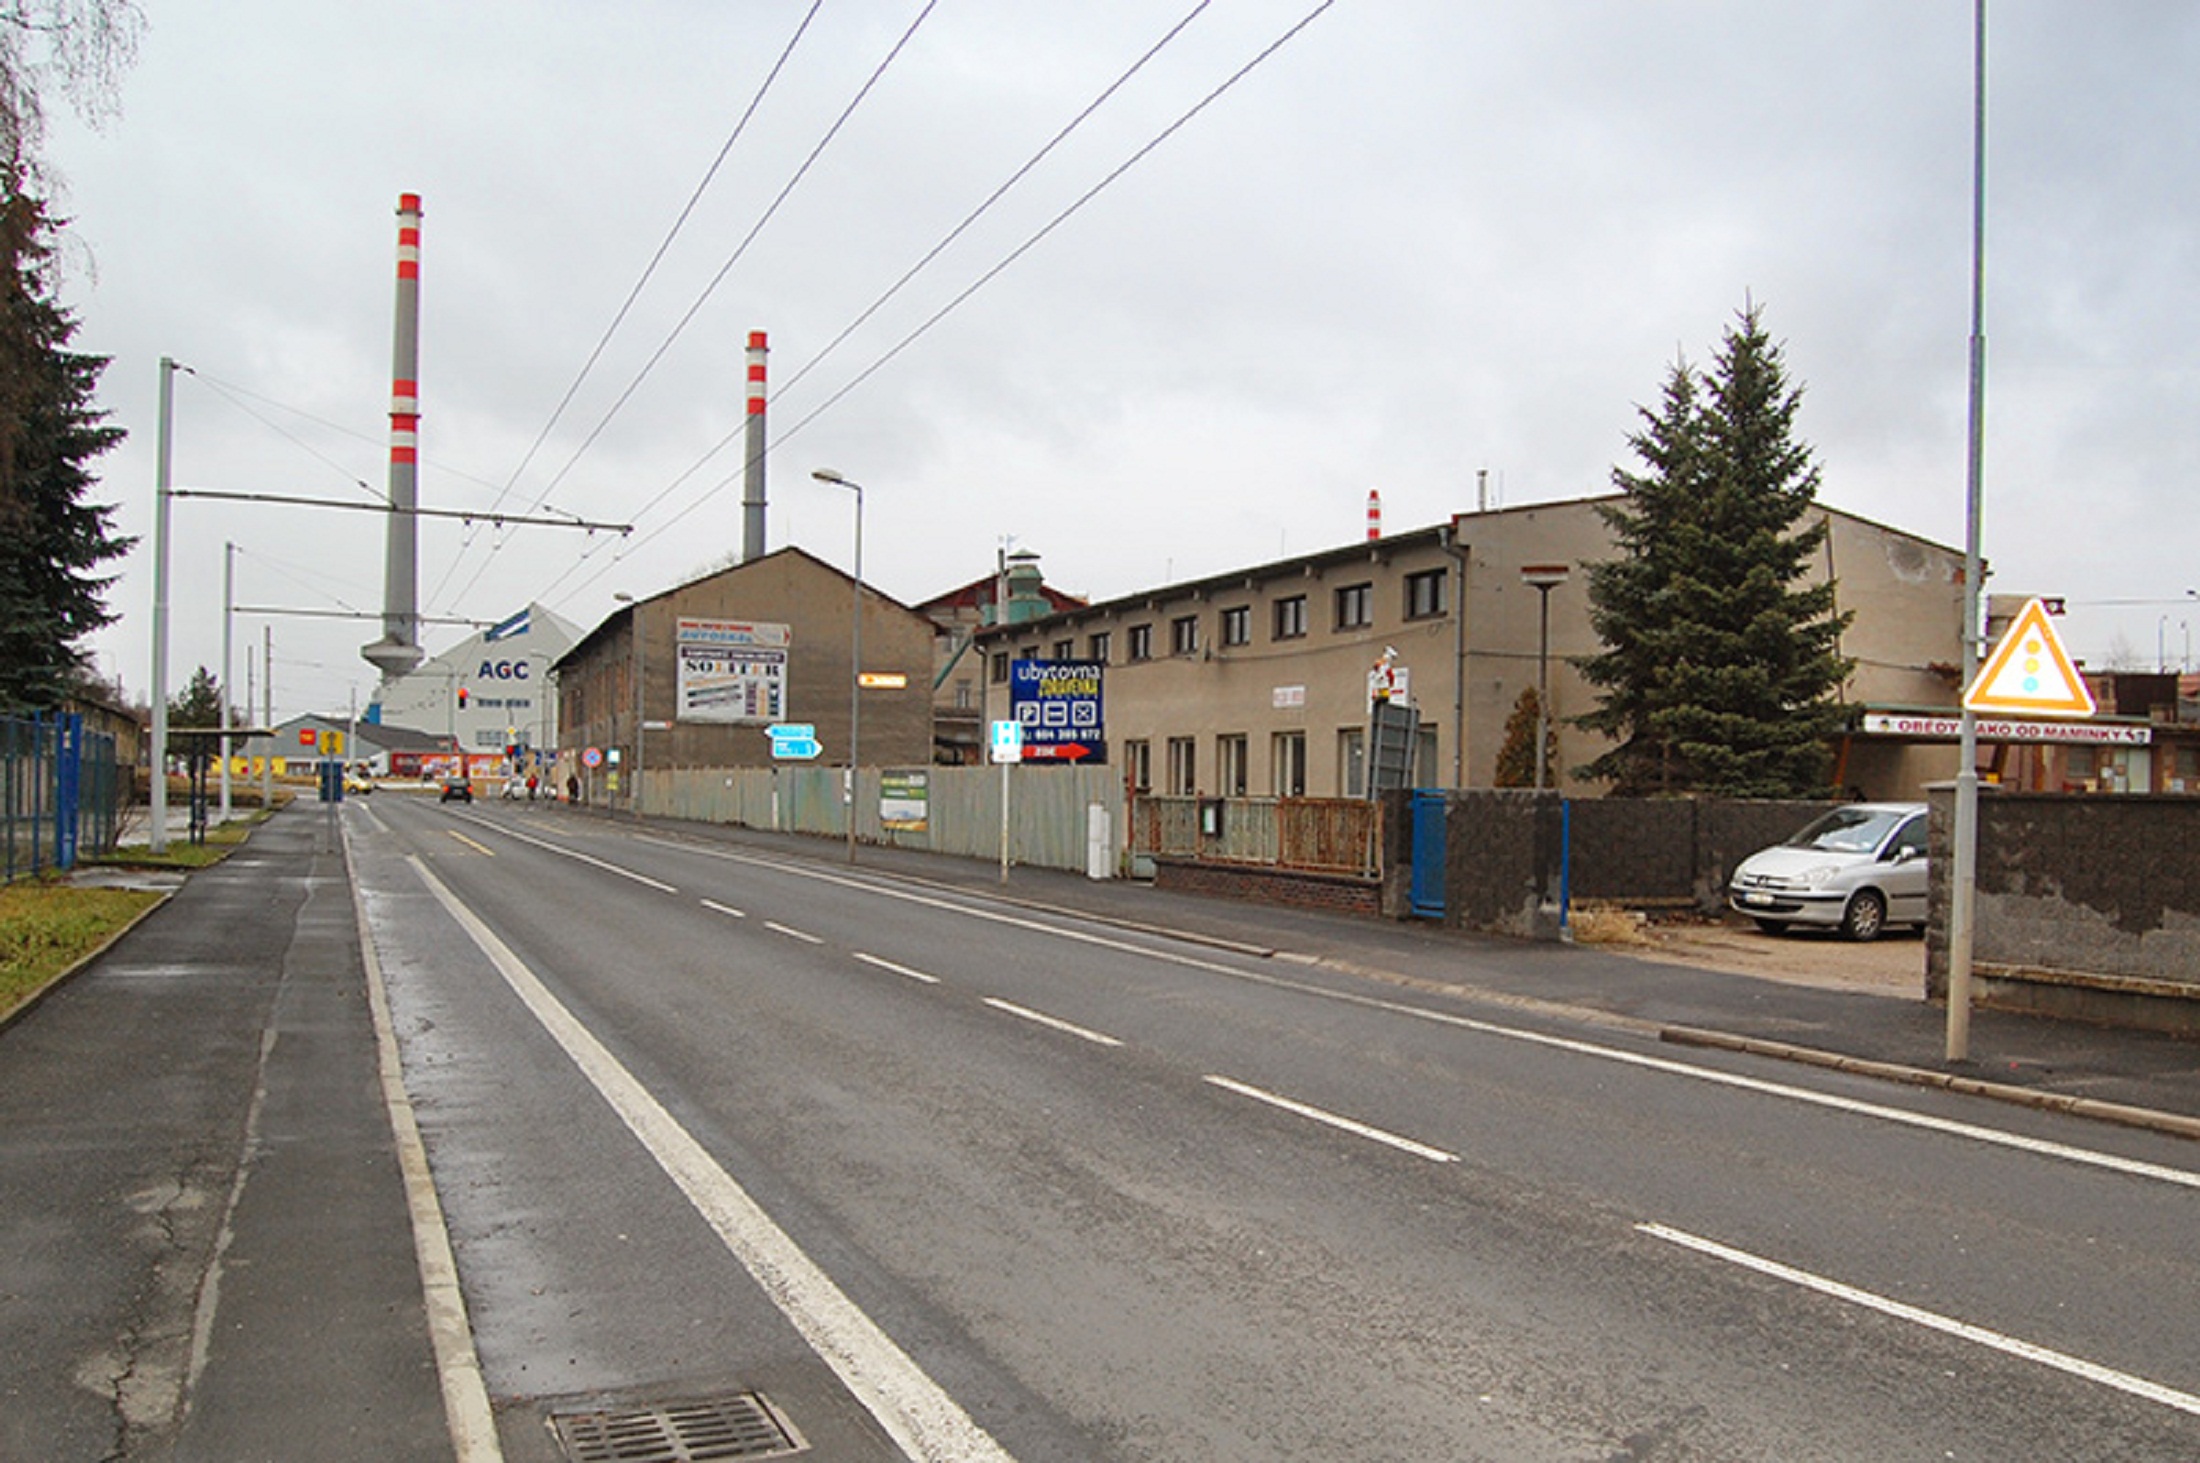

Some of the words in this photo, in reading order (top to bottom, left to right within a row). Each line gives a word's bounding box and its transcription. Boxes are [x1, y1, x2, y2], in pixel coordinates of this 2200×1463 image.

[478, 660, 529, 680] AGC
[1976, 722, 2012, 735] AKO
[2016, 725, 2040, 737] OD
[2044, 726, 2122, 740] MAMINKY
